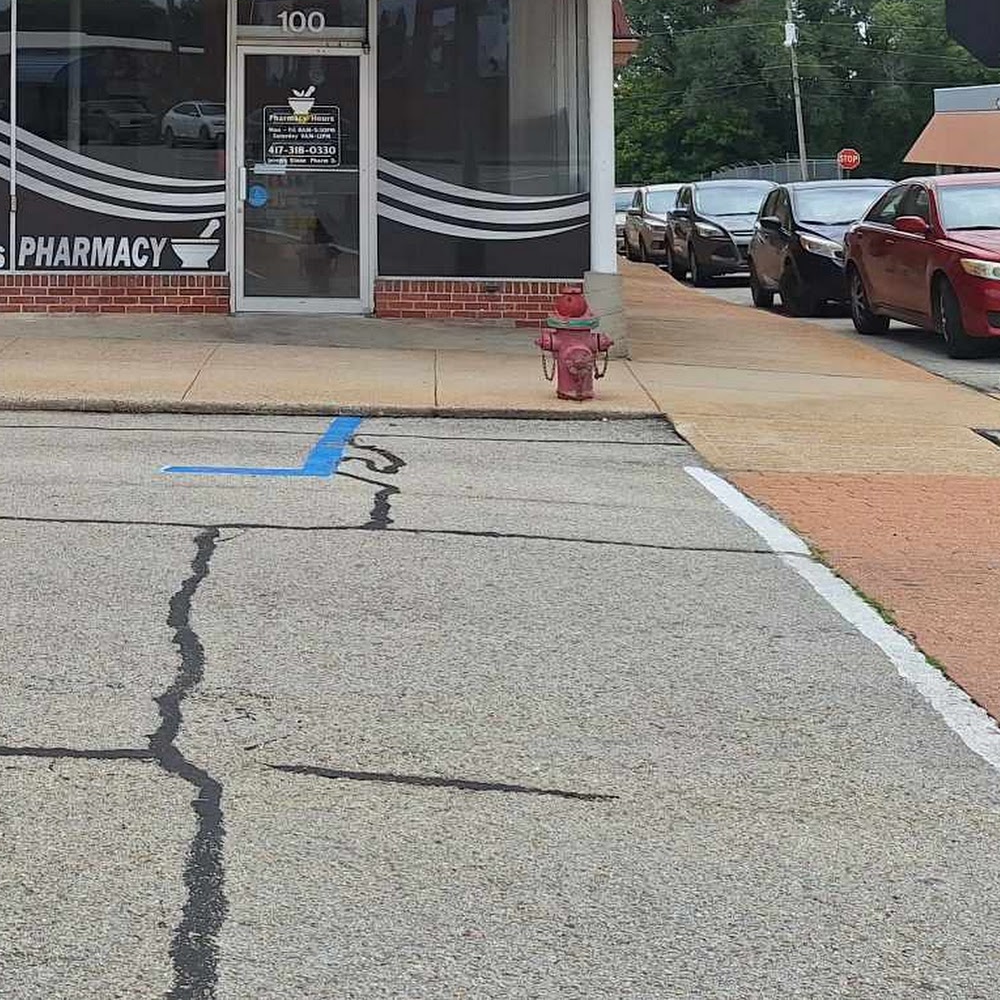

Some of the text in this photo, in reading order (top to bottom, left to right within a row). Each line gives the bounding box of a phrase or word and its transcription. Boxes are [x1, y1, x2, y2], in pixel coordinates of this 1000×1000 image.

[277, 10, 325, 32] 100
[311, 114, 335, 122] Hours
[268, 146, 336, 155] 417-318-0330
[840, 154, 858, 163] STOP
[17, 236, 168, 268] PHARMACY
